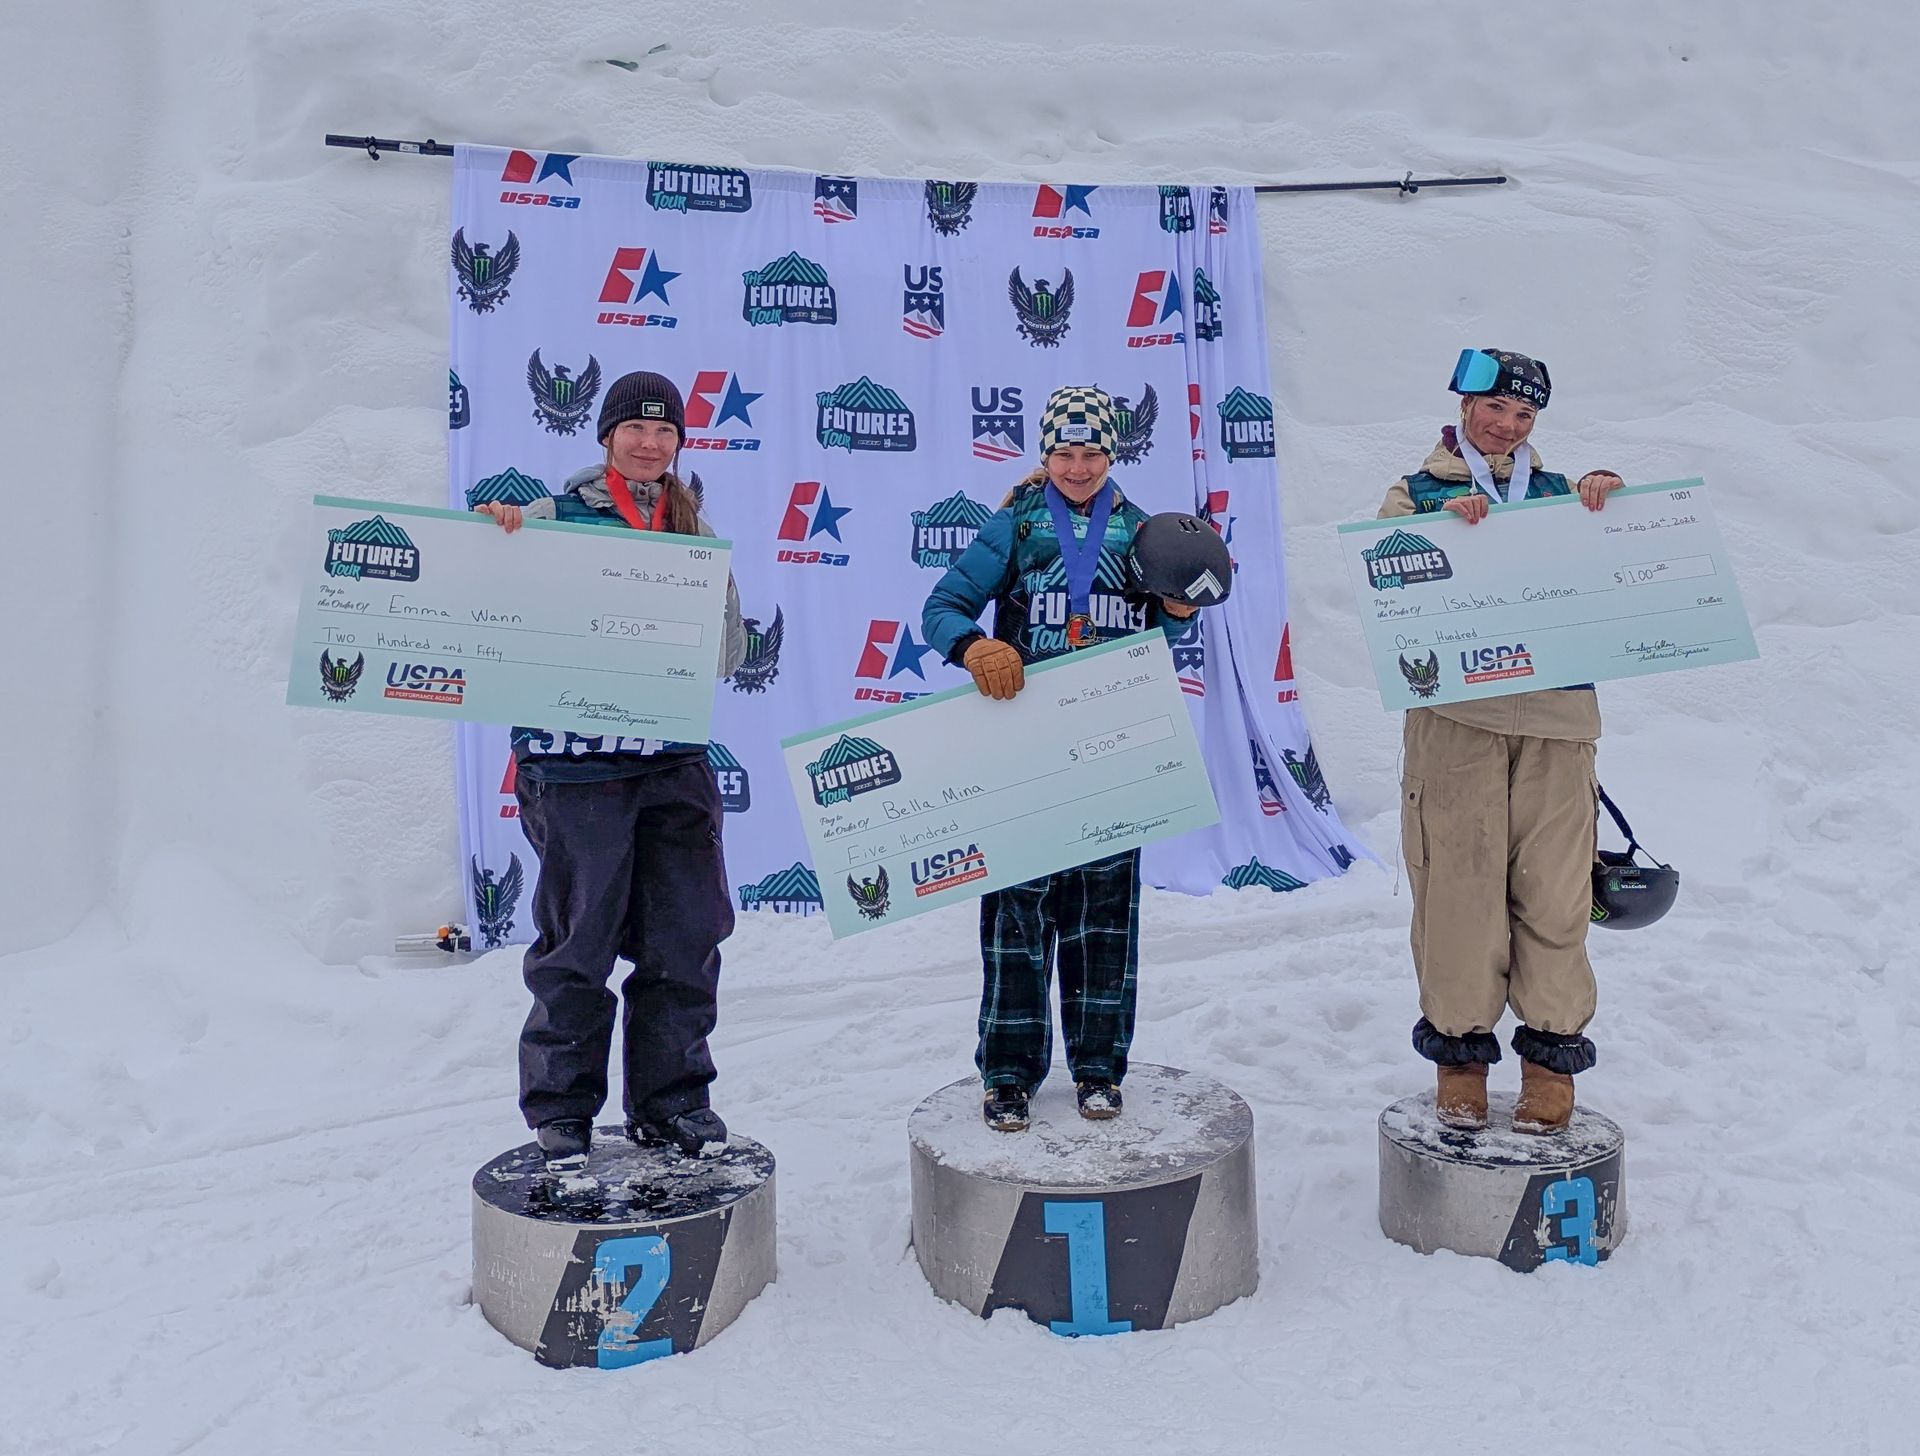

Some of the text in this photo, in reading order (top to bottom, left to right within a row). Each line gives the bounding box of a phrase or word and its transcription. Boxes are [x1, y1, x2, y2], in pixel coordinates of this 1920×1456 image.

[653, 169, 744, 197] FUTURES
[652, 191, 687, 214] TOUR
[743, 271, 766, 286] THE
[904, 264, 944, 292] US
[750, 285, 832, 308] FUTURES
[749, 306, 782, 326] TOUR
[1127, 332, 1187, 347] usas
[817, 393, 839, 407] THE
[971, 386, 1024, 413] US
[822, 407, 909, 436] FUTURES
[1225, 420, 1274, 443] TURE
[821, 429, 851, 454] TOUR
[1670, 491, 1692, 501] 1001
[912, 512, 932, 527] THE
[1628, 523, 1646, 532] Feb
[328, 529, 348, 542] THE
[918, 526, 979, 550] FUTU
[332, 543, 415, 568] FUTURES
[688, 549, 712, 561] 1001
[918, 549, 951, 570] TOUR
[1362, 549, 1379, 561] THE
[1371, 551, 1444, 577] FUTURES
[330, 560, 361, 581] TOUR
[630, 568, 649, 581] Feb
[1614, 572, 1623, 583] $
[320, 585, 335, 597] Pay
[1024, 571, 1053, 593] THE
[1374, 575, 1404, 590] TOUR
[331, 600, 354, 609] Order
[356, 602, 370, 614] Of
[389, 595, 522, 623] Emma Wann
[1374, 599, 1389, 608] Pay
[1389, 608, 1409, 617] Order
[1410, 605, 1422, 617] Of
[1442, 594, 1506, 611] Isabella
[590, 619, 599, 633] $
[377, 632, 430, 650] Hundred
[442, 644, 463, 654] and
[477, 644, 503, 663] Fifty
[1395, 628, 1478, 650] One Hundred
[1127, 645, 1150, 660] 1001
[1461, 643, 1532, 673] USPA
[387, 662, 463, 693] USPA
[1081, 688, 1102, 699] Feb
[1126, 673, 1150, 686] 2026
[854, 688, 934, 703] usas
[621, 714, 658, 727] Signature
[1069, 748, 1078, 761] $
[806, 761, 824, 775] THE
[816, 753, 893, 792] FUTURES
[819, 787, 851, 807] TOUR
[882, 784, 985, 820] Bella Mina
[820, 816, 835, 826] Pay
[824, 817, 869, 839] the Order Of
[1135, 818, 1169, 835] Signature
[847, 820, 959, 865] Five Hundred
[911, 843, 985, 885] USPA
[739, 885, 765, 903] THE
[1543, 1177, 1598, 1267] 3
[1044, 1201, 1132, 1337] 1
[596, 1236, 673, 1370] 2
